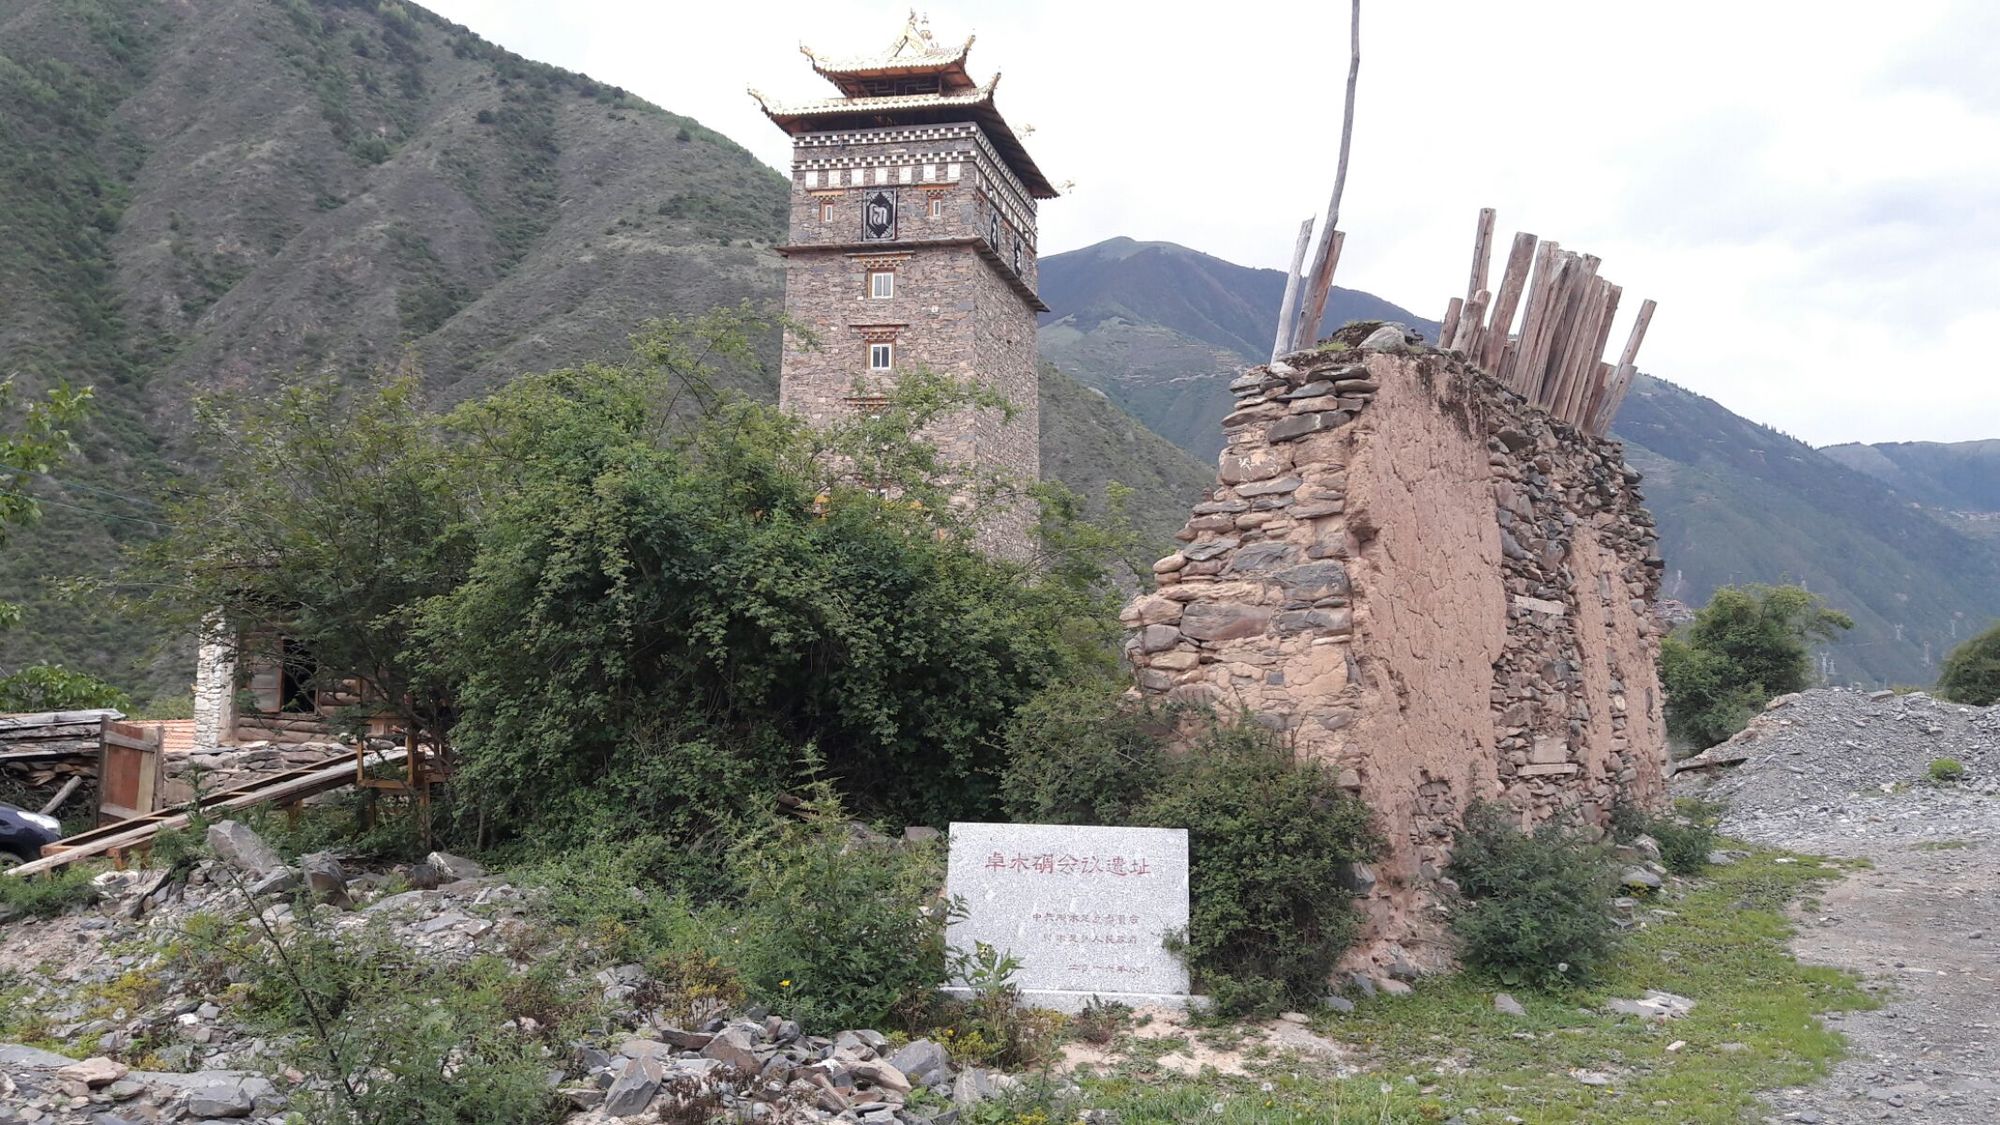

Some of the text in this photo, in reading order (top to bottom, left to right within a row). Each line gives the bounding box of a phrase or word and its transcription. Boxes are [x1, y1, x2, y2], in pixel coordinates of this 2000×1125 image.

[985, 851, 1151, 877] 卓木碉会议遗址
